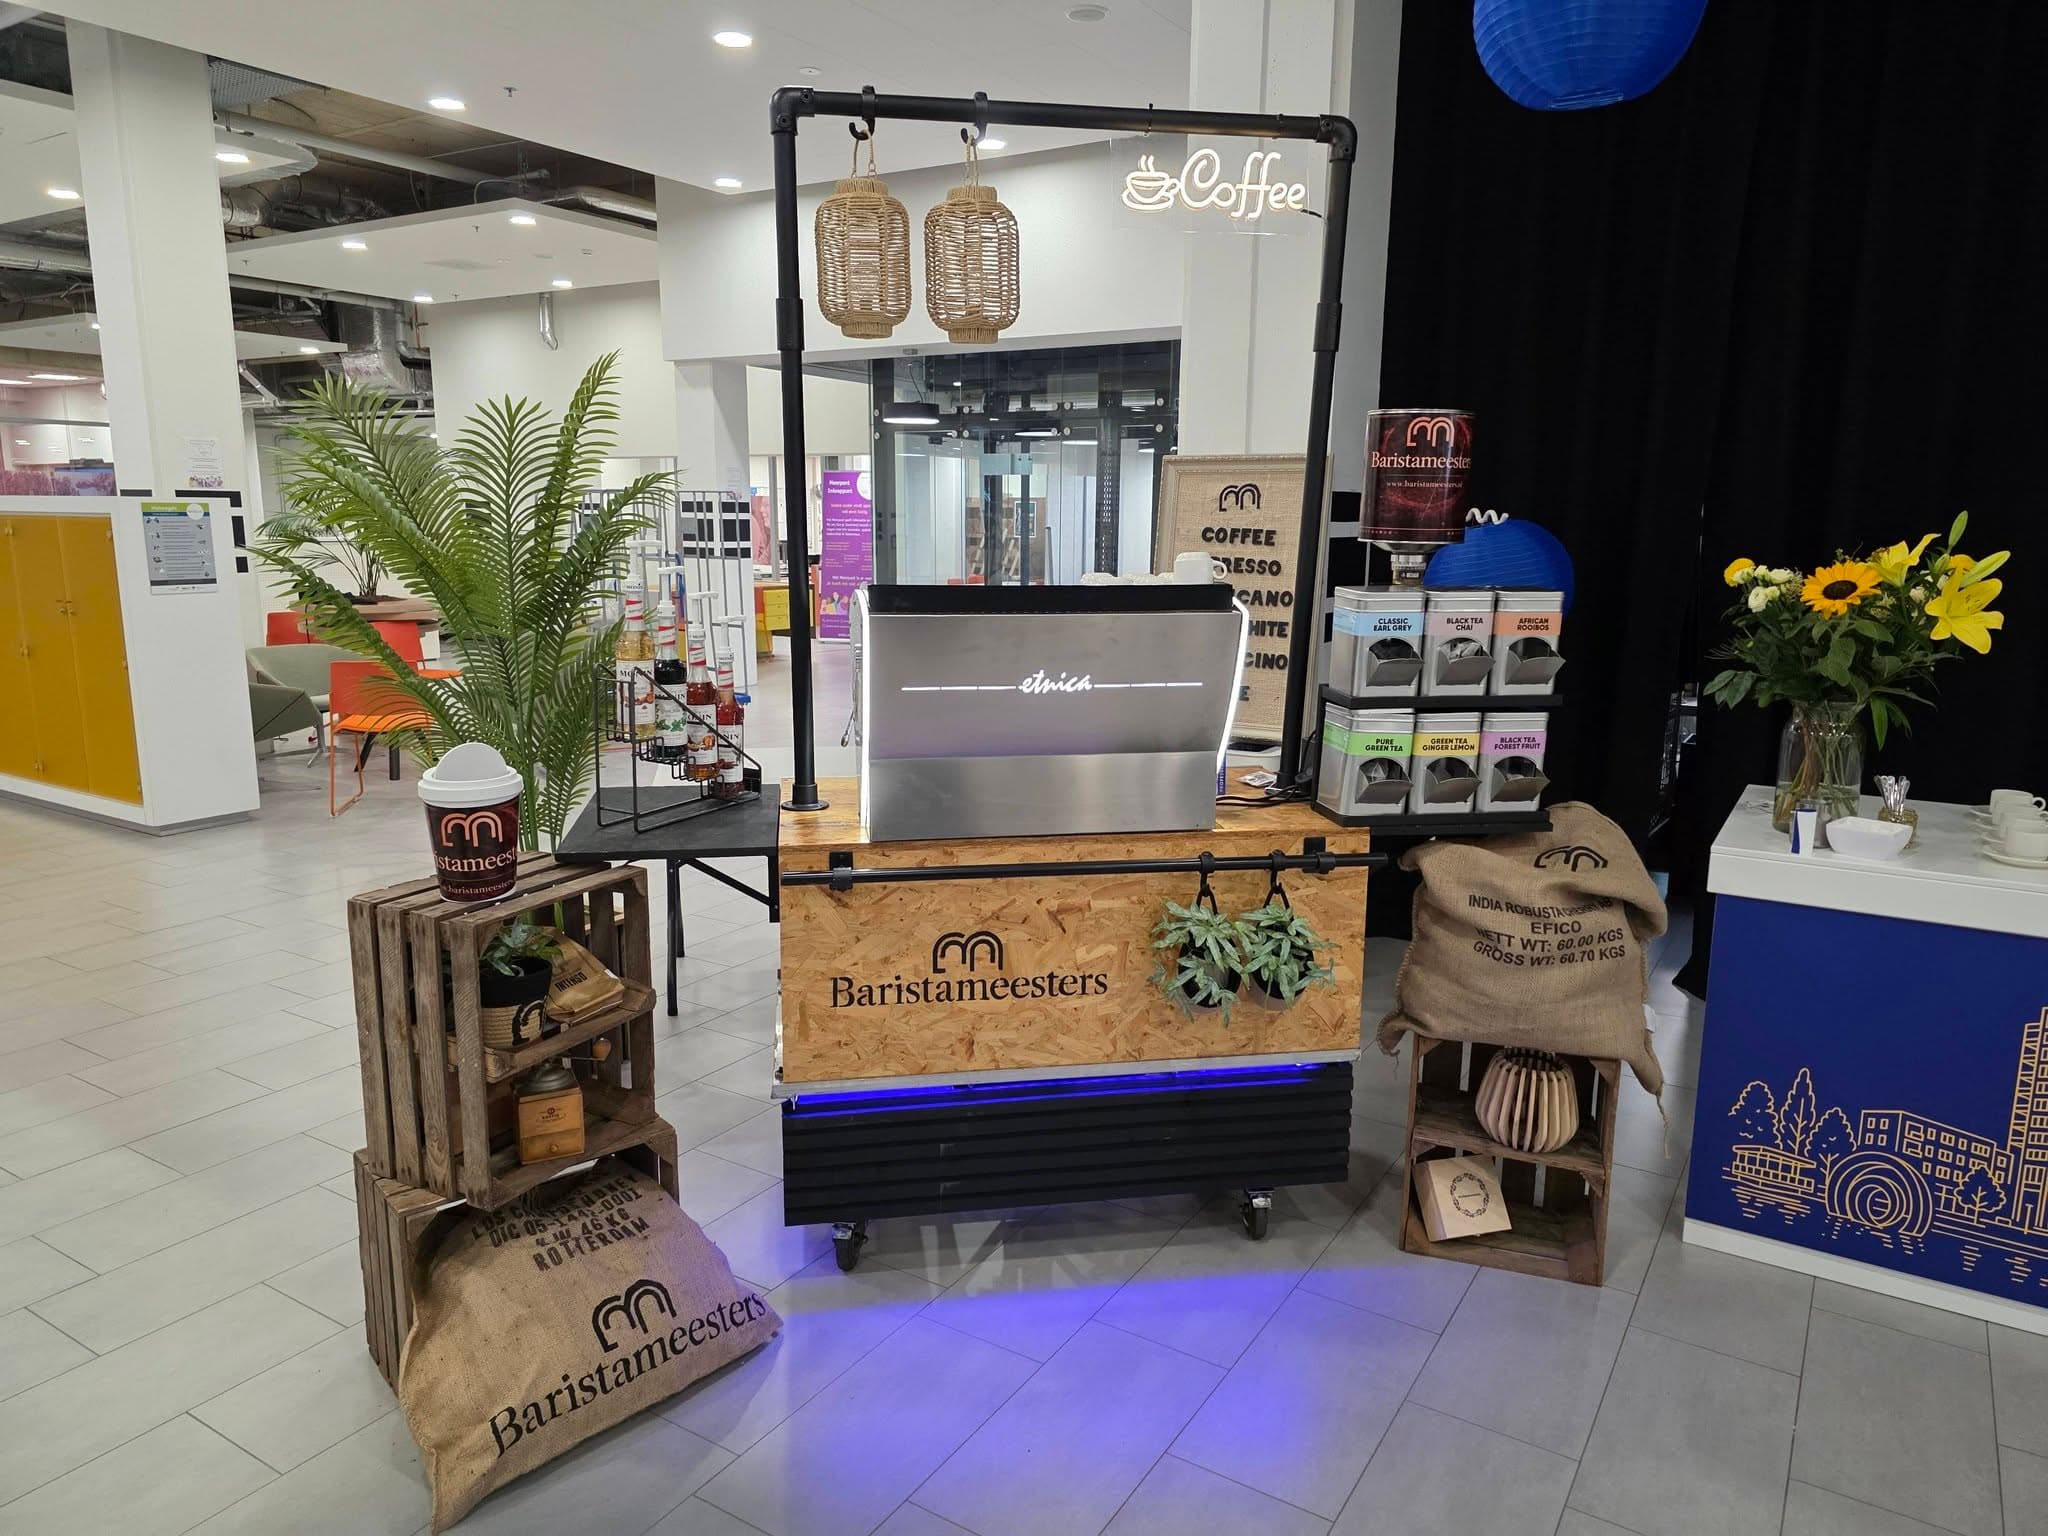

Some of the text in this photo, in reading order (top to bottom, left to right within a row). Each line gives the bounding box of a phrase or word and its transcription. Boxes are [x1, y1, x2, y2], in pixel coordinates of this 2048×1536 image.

[1180, 148, 1306, 221] Coffee
[1201, 526, 1277, 546] COFFEE
[1233, 589, 1294, 607] CANO
[619, 669, 653, 678] MON
[1018, 669, 1094, 694] etnica
[1468, 894, 1502, 912] INDIA
[1505, 901, 1564, 919] ROBUSTA
[1519, 937, 1552, 952] WT:
[1556, 934, 1594, 951] 60.00
[1597, 928, 1624, 944] KGS
[1530, 920, 1582, 935] EFICO
[1473, 940, 1626, 967] GROSS WT: 60.70 KGS
[829, 970, 1109, 1008] Baristameesters
[581, 1218, 603, 1236] 46
[604, 1207, 630, 1228] KG
[532, 1216, 650, 1272] ROTTERDAM
[487, 1290, 767, 1458] Baristameesters
